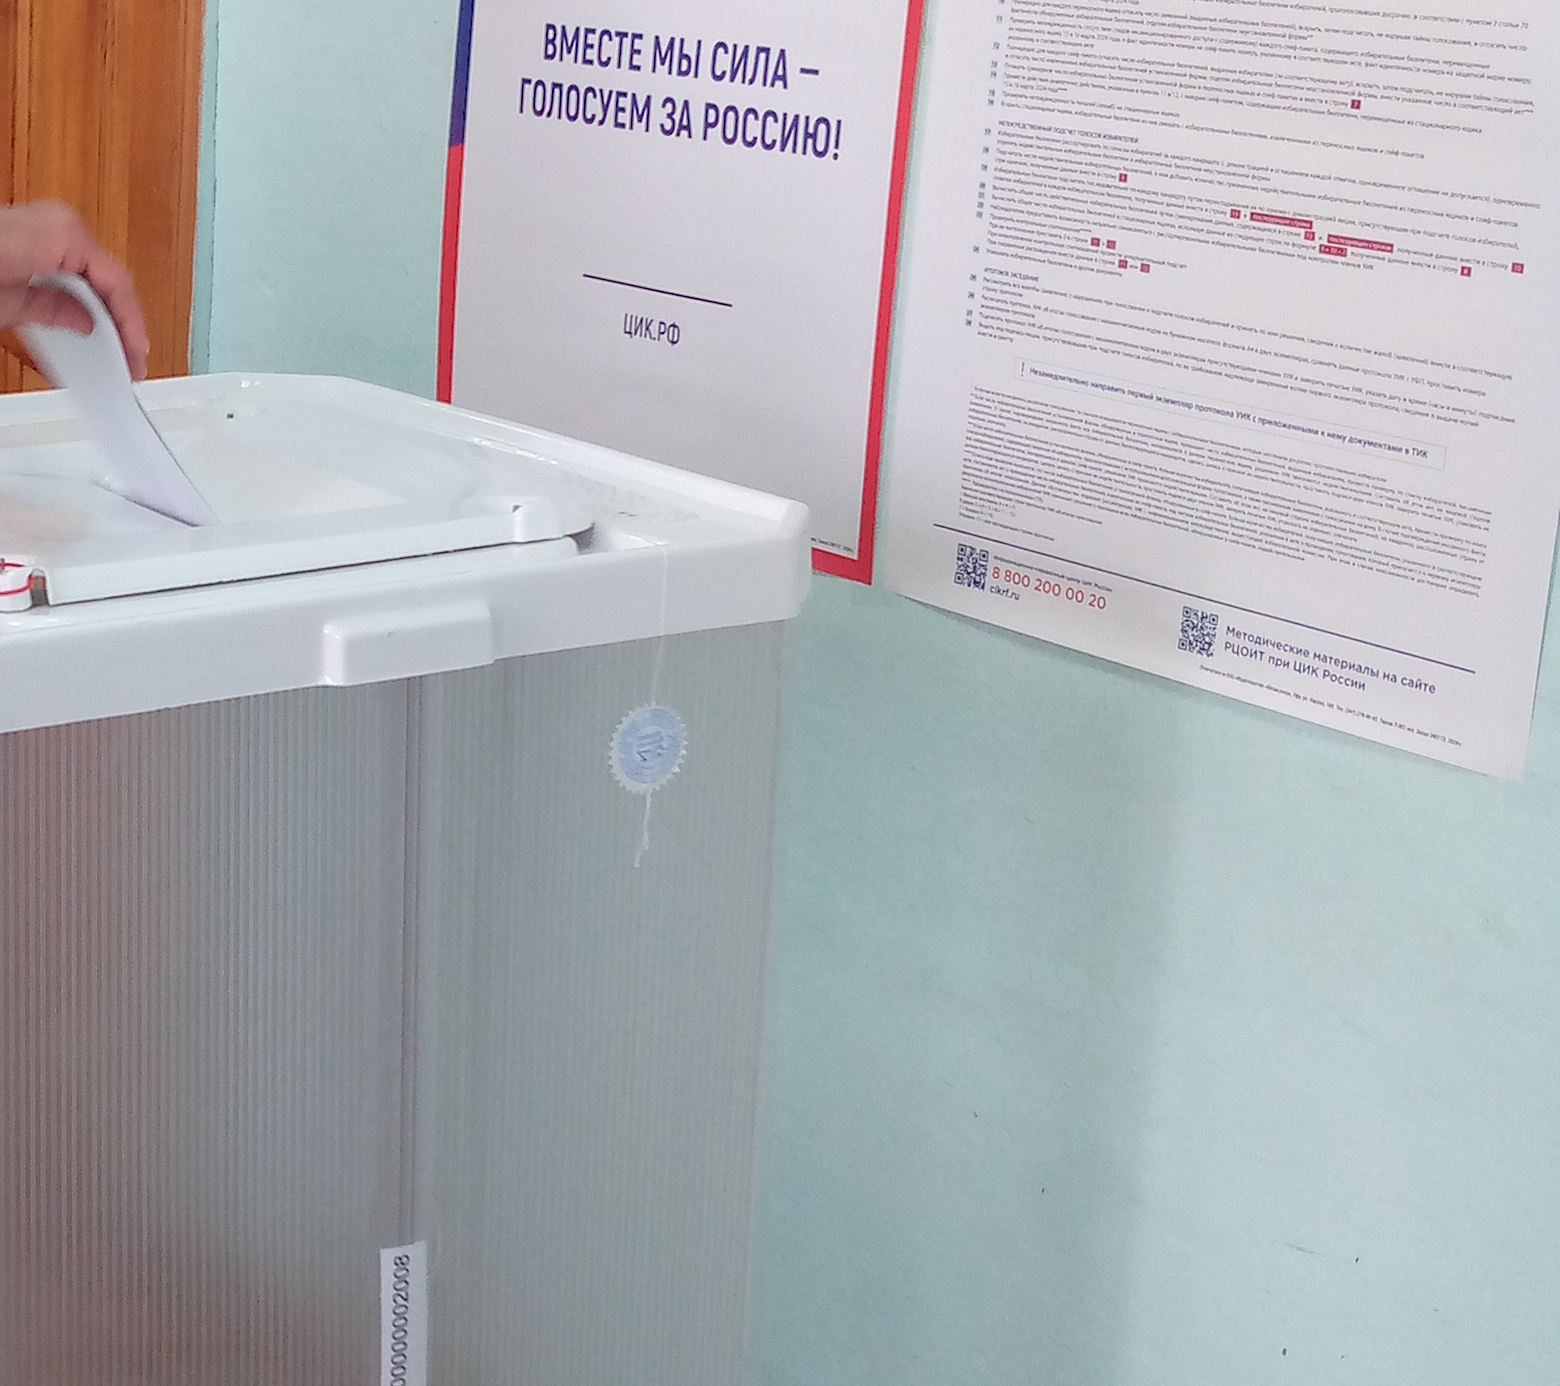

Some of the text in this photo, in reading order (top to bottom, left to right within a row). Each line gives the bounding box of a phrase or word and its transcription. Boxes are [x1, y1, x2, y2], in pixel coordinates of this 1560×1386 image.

[543, 23, 644, 72] ВМЕСТЕ
[651, 35, 701, 79] МЫ
[710, 42, 789, 89] СИЛА
[519, 77, 842, 160] ГОЛОСУЕМ ЗА РОССИЮ!
[623, 313, 680, 347] ЦИК.РФ
[1127, 389, 1154, 400] первый
[1194, 404, 1235, 418] протокола
[1235, 410, 1252, 421] УИК
[1411, 447, 1429, 459] ТИК
[989, 585, 1020, 601] cikrf.ru
[991, 566, 1107, 610] 8 800 200 00 20
[1224, 641, 1265, 663] РЦОИТ
[1267, 655, 1290, 669] при
[1293, 660, 1320, 678] ЦИК
[1322, 669, 1366, 691] России
[1225, 625, 1436, 694] Методические материалы на сайте
